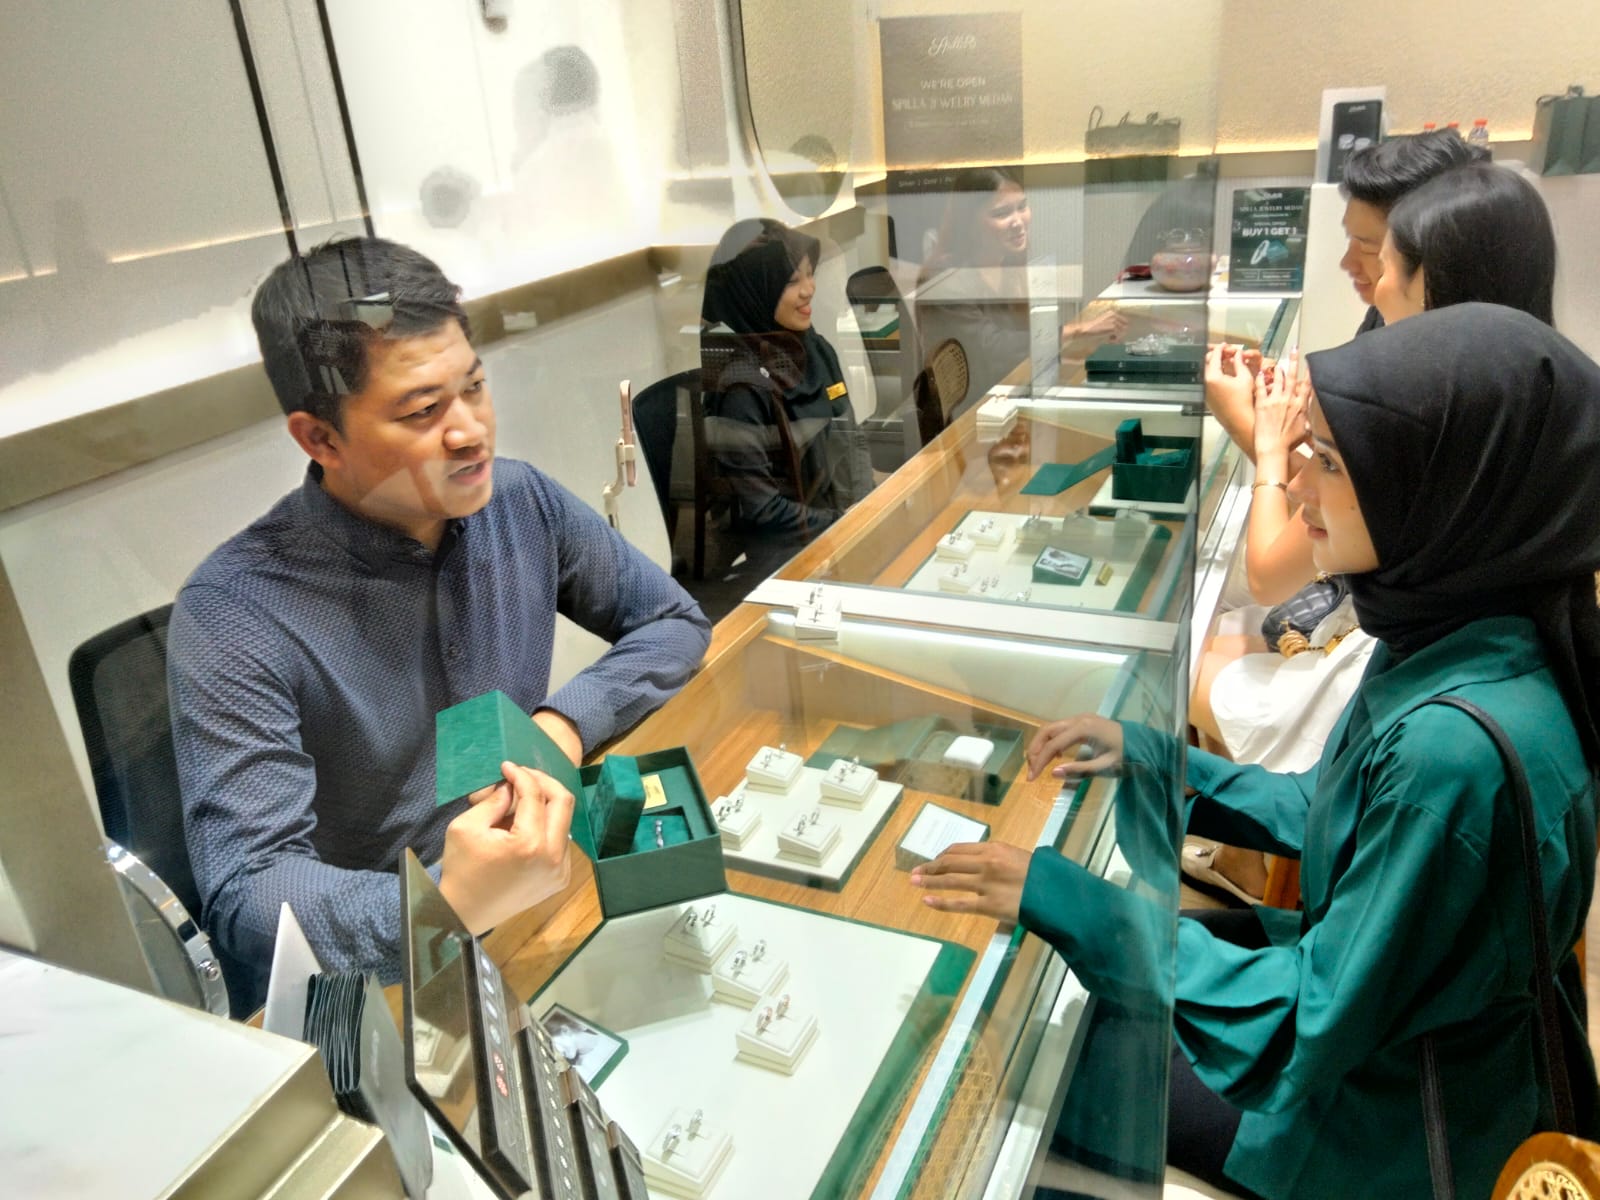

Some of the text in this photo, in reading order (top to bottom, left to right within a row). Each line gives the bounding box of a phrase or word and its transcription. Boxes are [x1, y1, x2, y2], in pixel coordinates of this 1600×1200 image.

[957, 76, 986, 88] OPEN
[1242, 227, 1297, 237] BUY 1 GET 1
